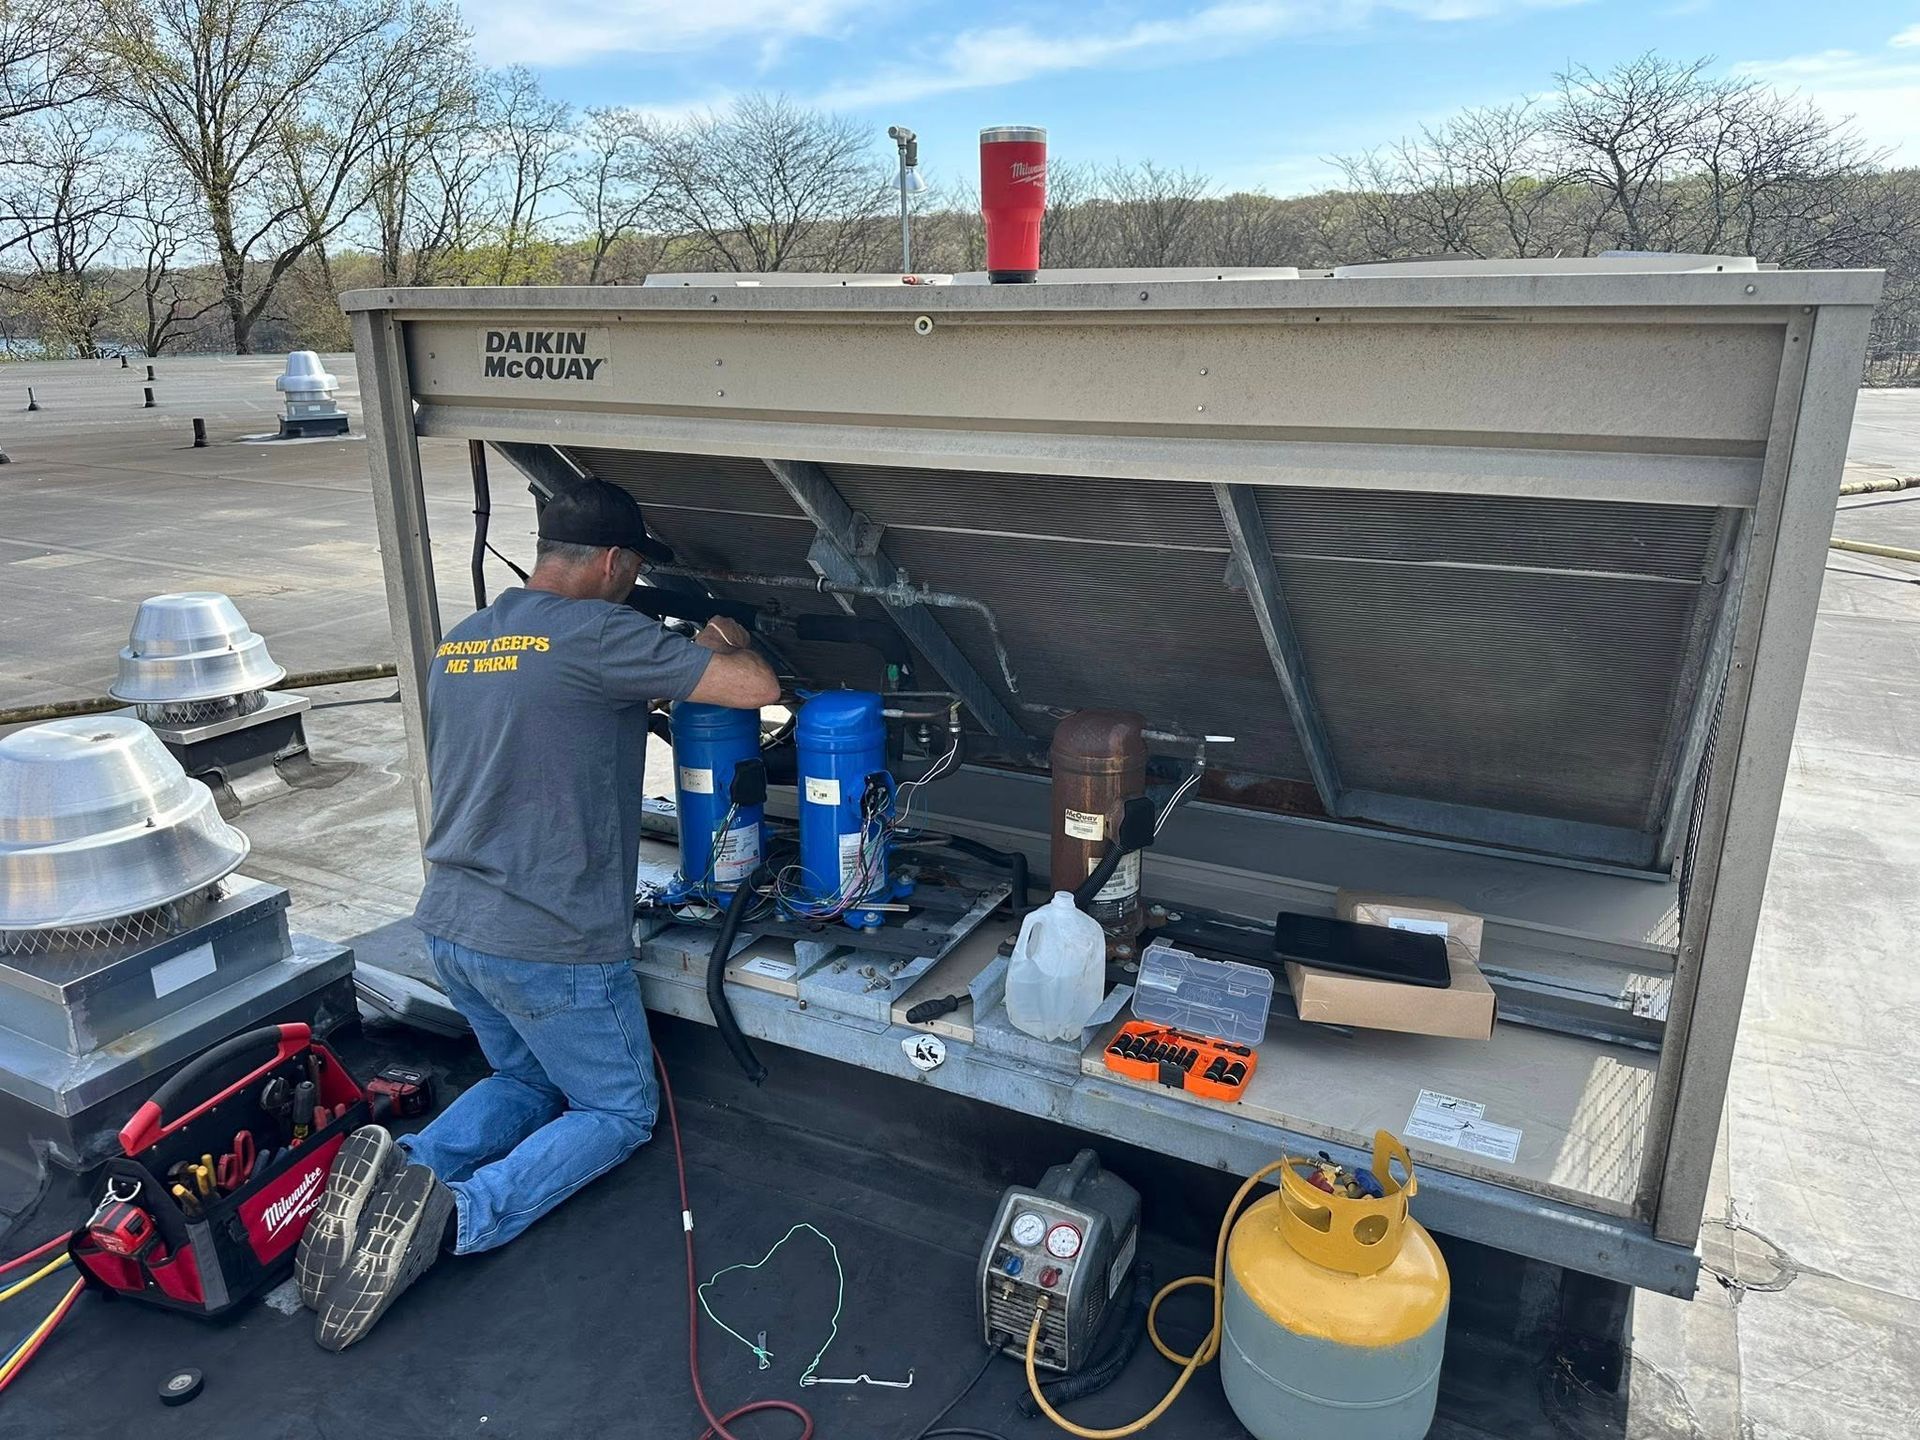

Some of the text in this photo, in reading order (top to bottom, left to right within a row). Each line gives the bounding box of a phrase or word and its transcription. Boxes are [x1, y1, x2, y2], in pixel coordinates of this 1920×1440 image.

[485, 331, 587, 355] DAIKIN
[484, 356, 603, 380] McQUAY
[491, 635, 550, 652] KEEPS
[444, 655, 518, 673] ME WARM
[1066, 810, 1097, 822] McQuay
[260, 1167, 323, 1231] Milwaukee
